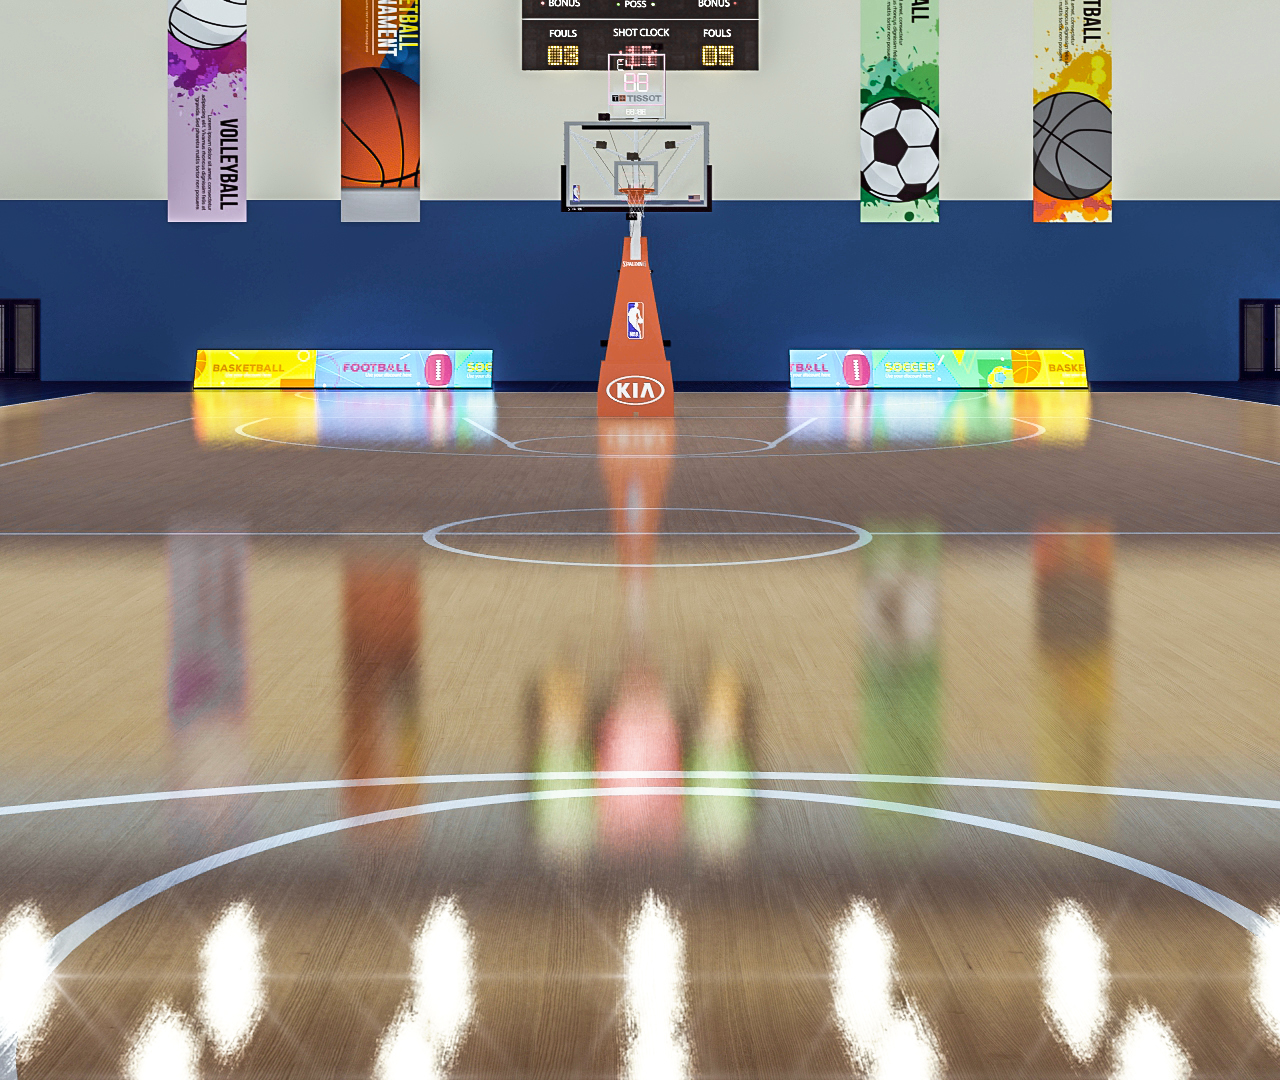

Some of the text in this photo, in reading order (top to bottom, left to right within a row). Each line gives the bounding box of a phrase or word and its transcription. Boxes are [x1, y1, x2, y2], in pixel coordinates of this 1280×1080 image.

[624, 0, 647, 8] POSS
[549, 29, 578, 38] FOULS
[613, 28, 670, 37] SHOT CLOCK
[703, 29, 732, 38] FOULS
[702, 45, 734, 66] 05
[627, 94, 662, 102] TISSOT
[220, 118, 238, 210] VOLLEYBALL
[213, 364, 284, 372] BASKETBALL
[343, 362, 411, 372] FOOTBALL
[884, 362, 936, 372] SOCCER
[1049, 364, 1085, 372] BASKE
[616, 382, 655, 398] KIA
